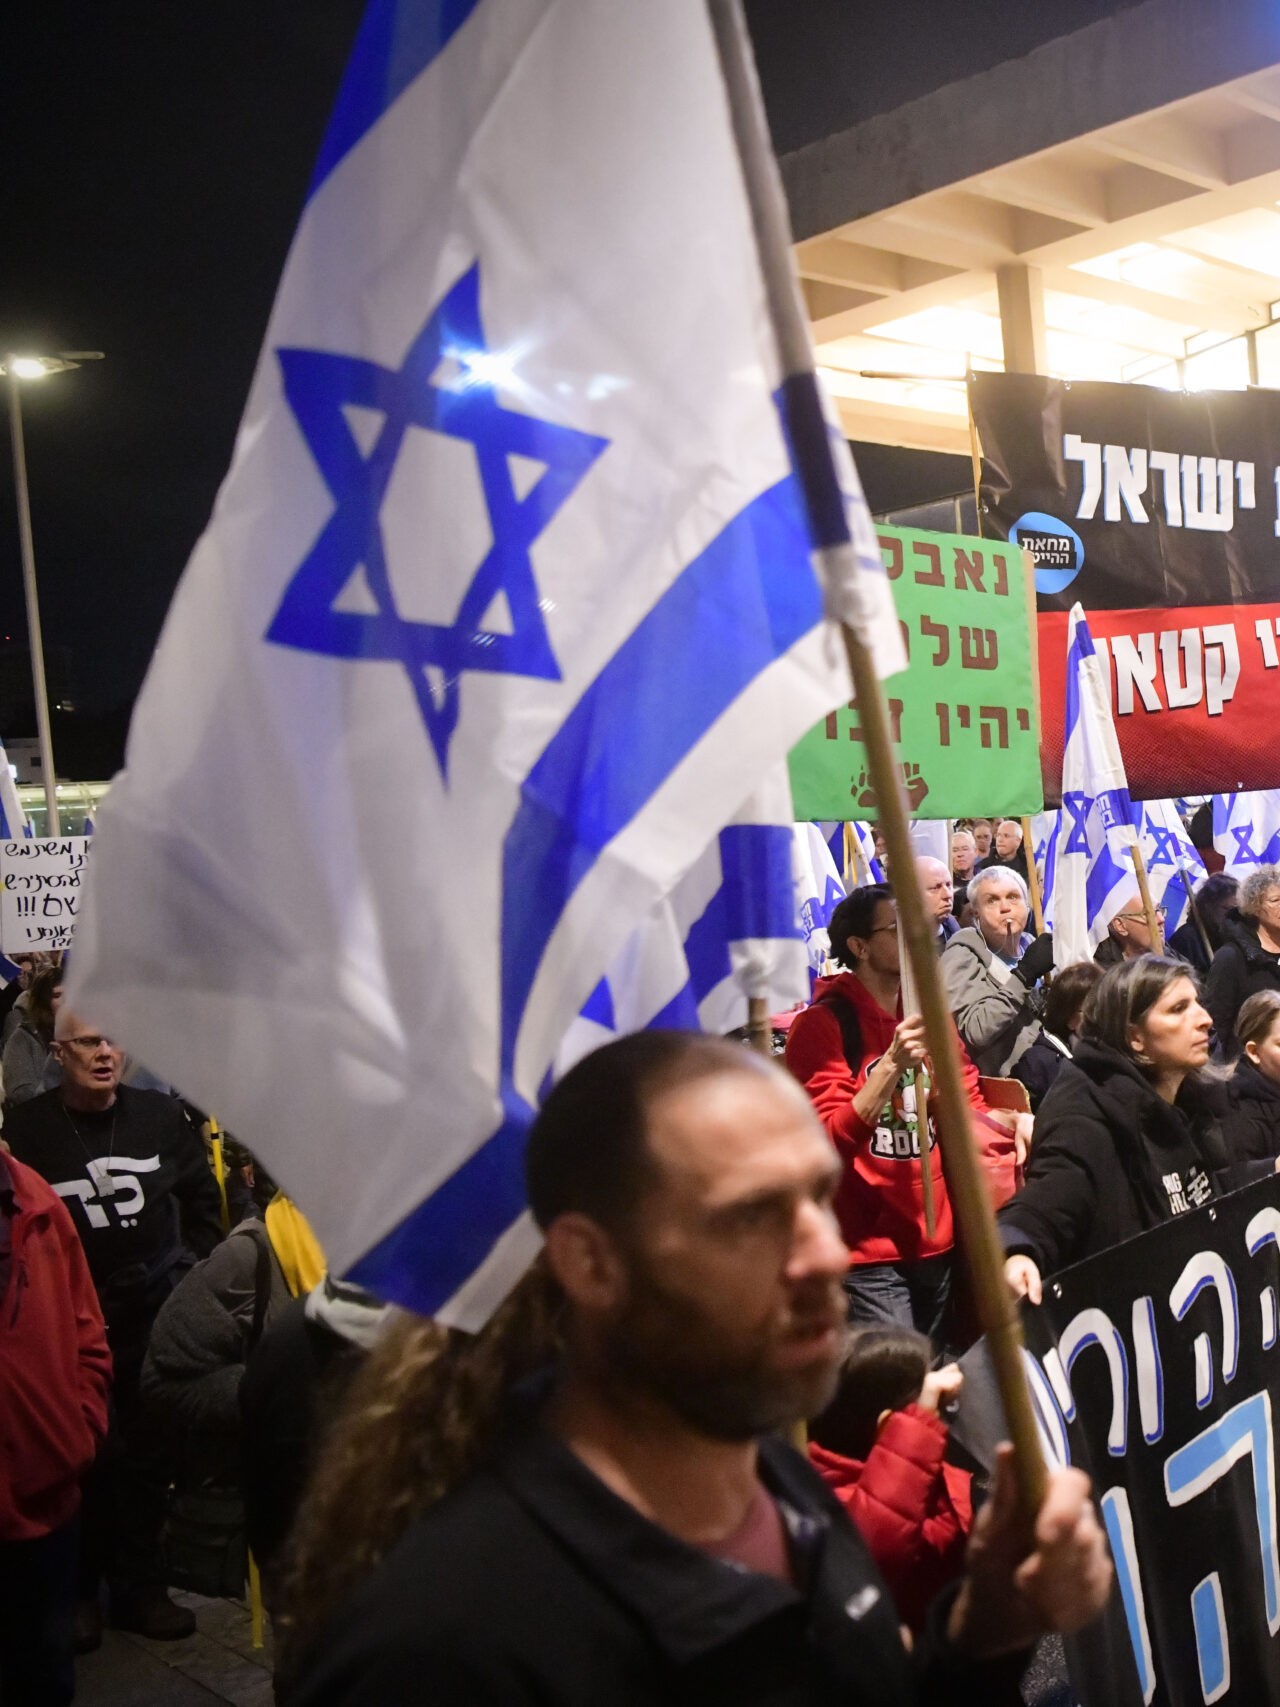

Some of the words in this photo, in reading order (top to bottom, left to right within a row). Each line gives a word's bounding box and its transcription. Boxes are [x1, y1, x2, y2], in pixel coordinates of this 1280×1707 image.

[1063, 433, 1256, 533] ישראל
[1022, 537, 1070, 552] מחאת
[1033, 551, 1070, 564] ההייט
[935, 702, 1031, 750] יהיו
